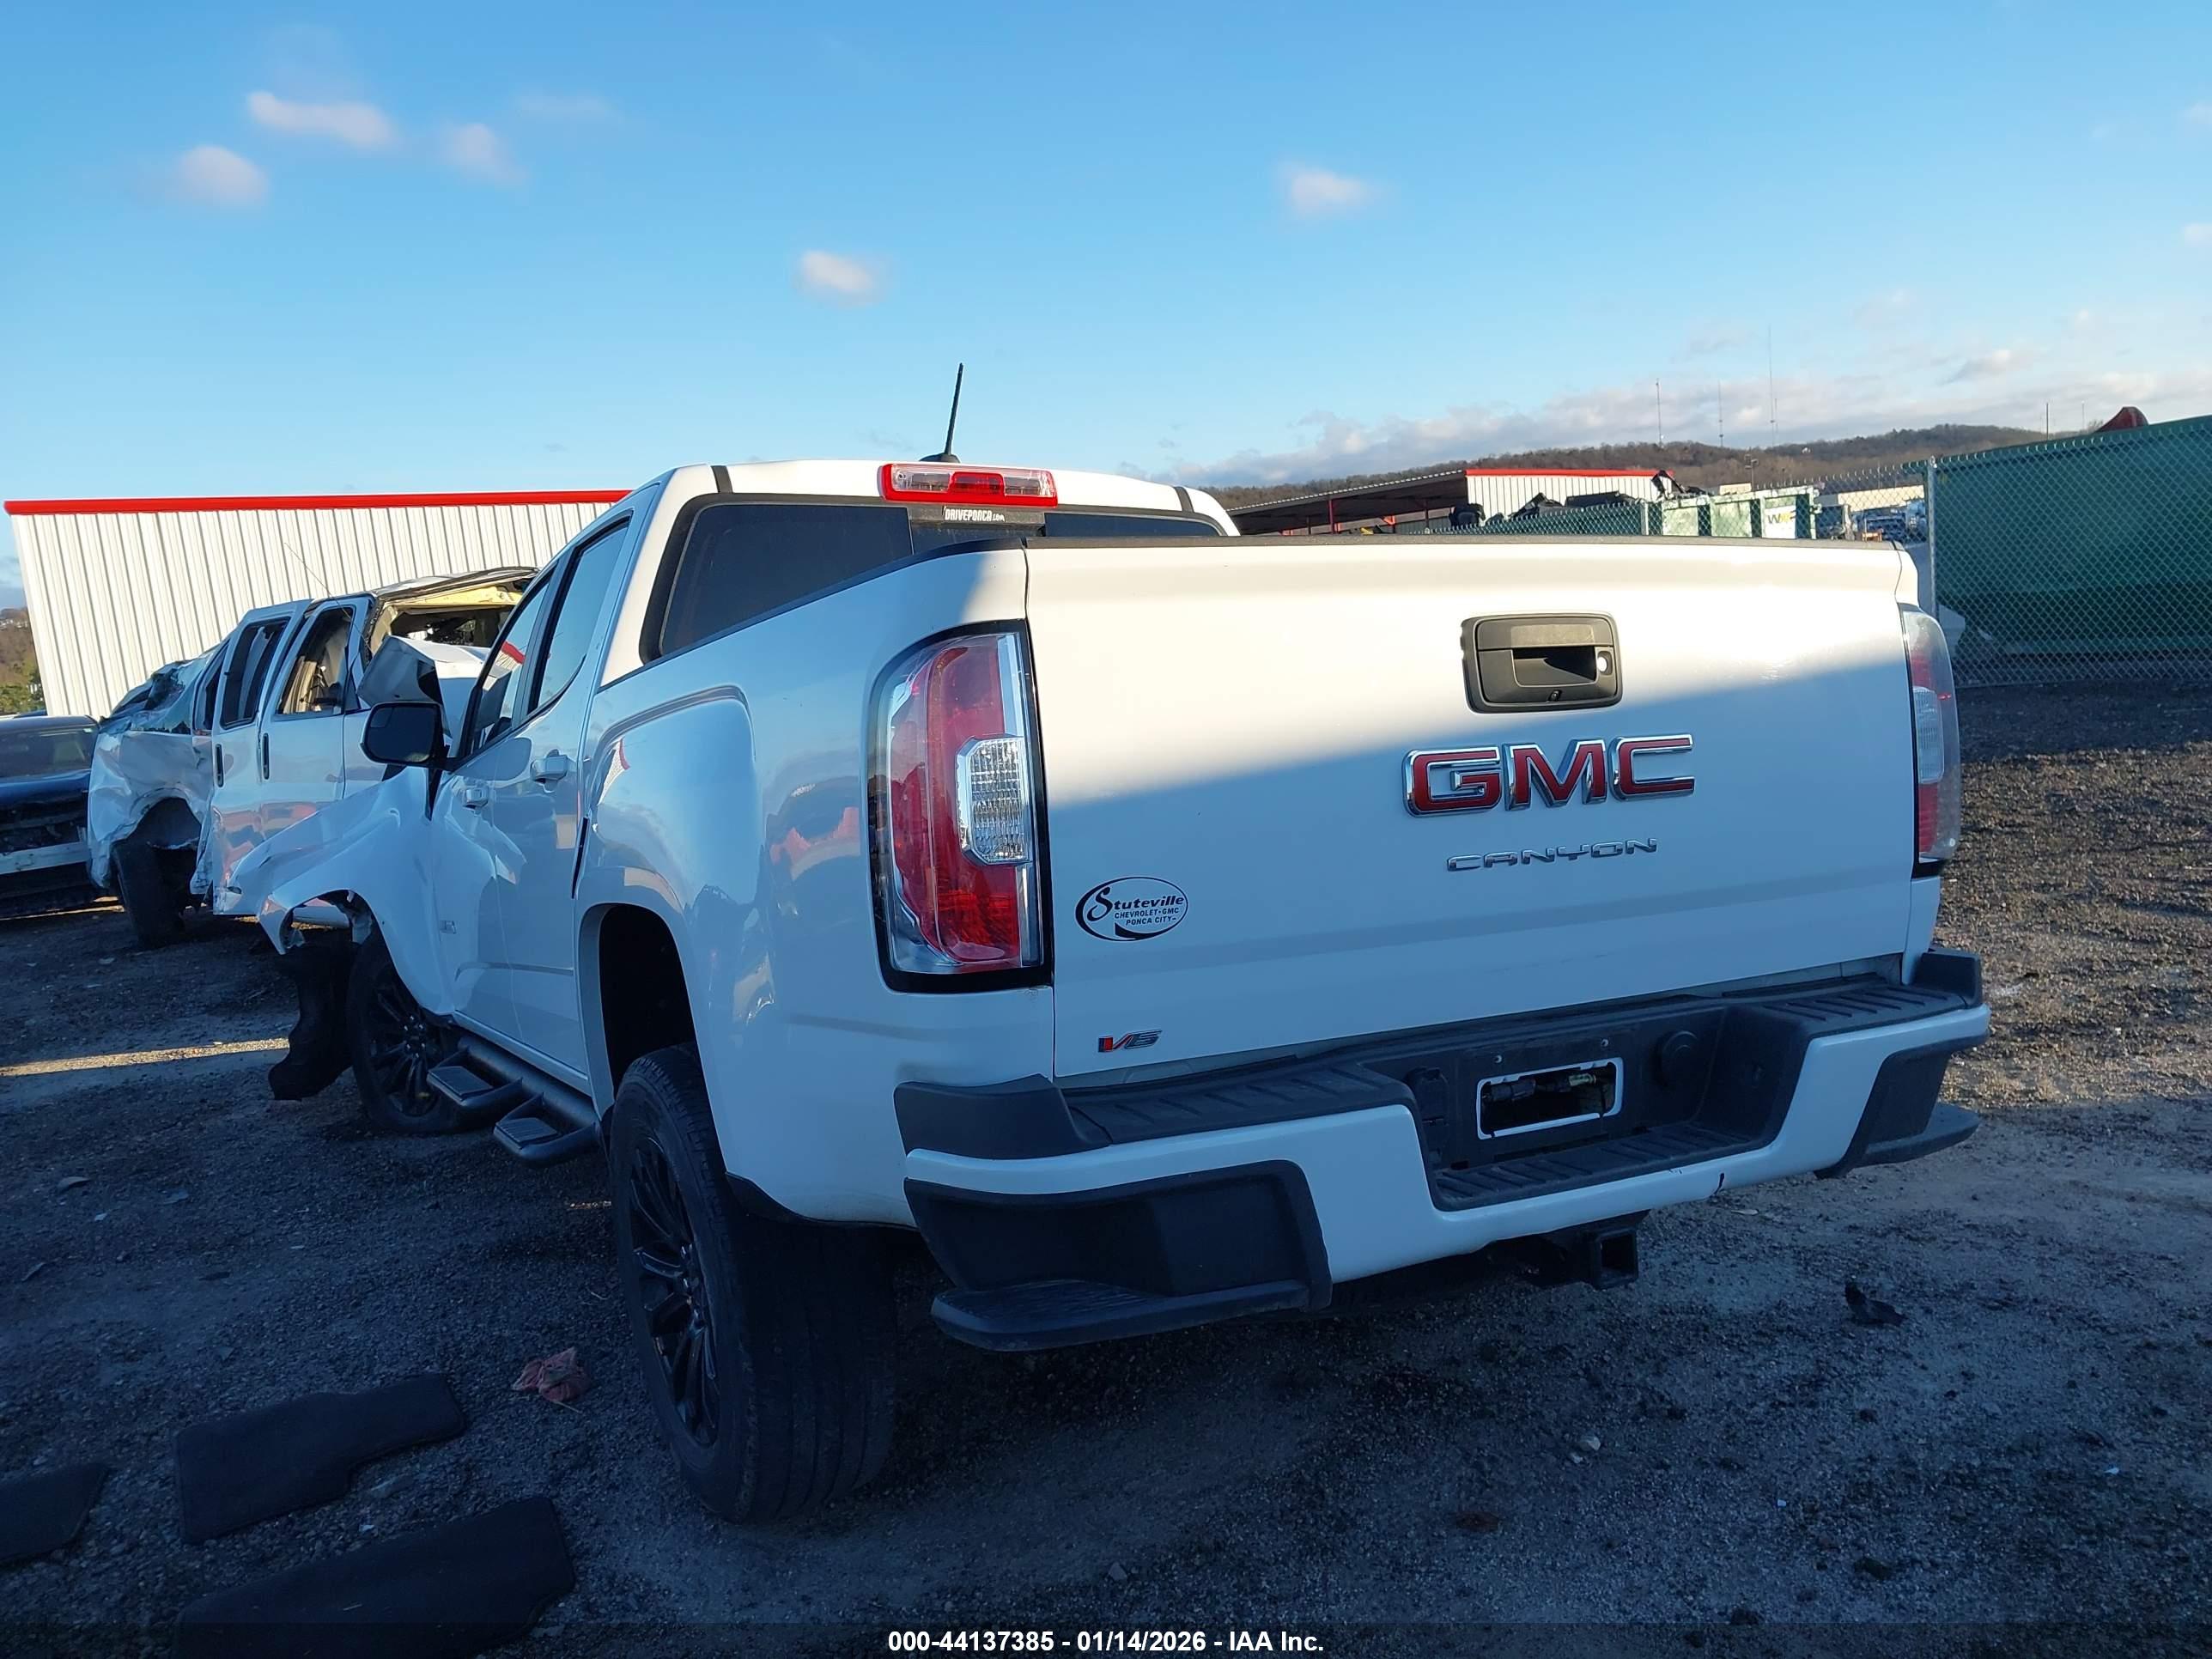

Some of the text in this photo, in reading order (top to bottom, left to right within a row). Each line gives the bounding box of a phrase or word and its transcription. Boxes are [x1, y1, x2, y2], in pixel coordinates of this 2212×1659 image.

[1402, 734, 1695, 817] GMC
[1447, 838, 1656, 872] CANYON
[1086, 886, 1184, 921] Stuteville
[1098, 1030, 1162, 1053] V6
